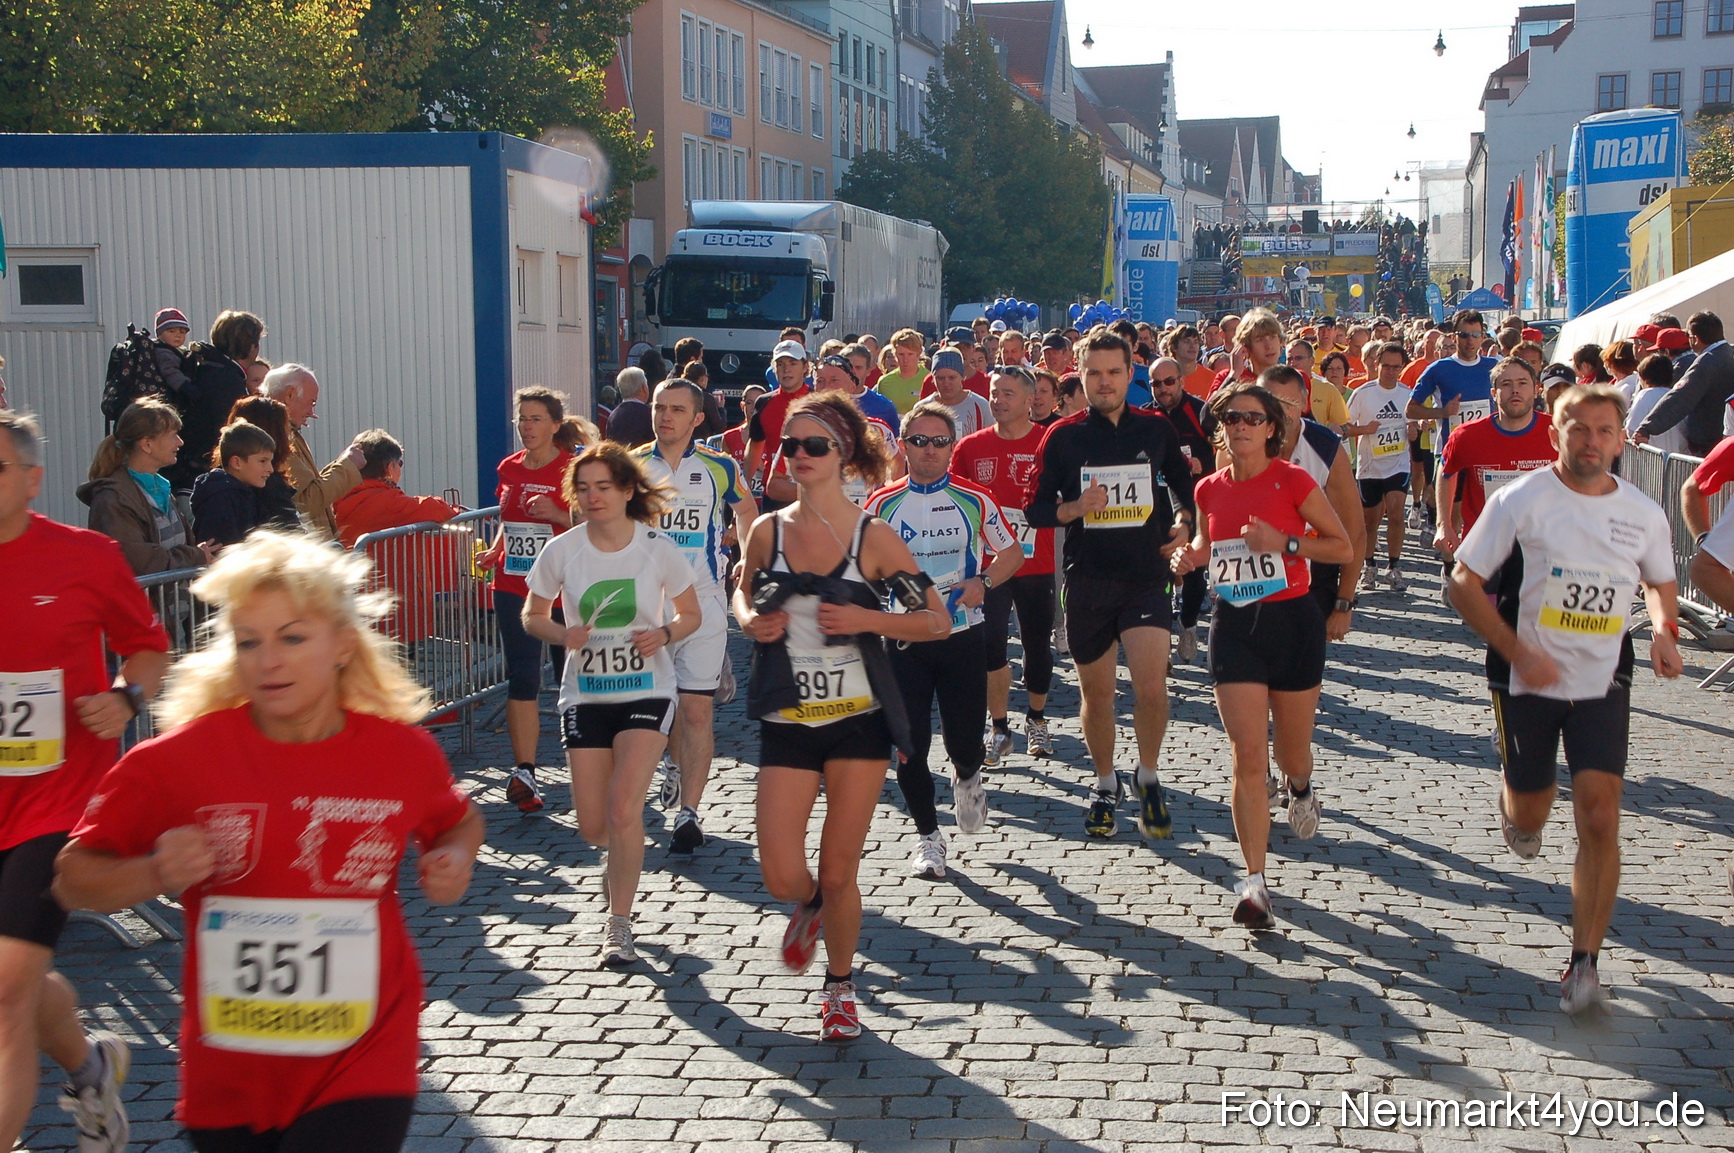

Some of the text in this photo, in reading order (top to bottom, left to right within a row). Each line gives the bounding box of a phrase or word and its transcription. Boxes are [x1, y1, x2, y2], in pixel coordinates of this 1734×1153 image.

[1593, 127, 1670, 170] maxi
[1128, 207, 1163, 231] axi
[703, 233, 773, 248] BOCK
[1141, 243, 1160, 258] dsl
[1376, 411, 1402, 419] adidas
[1378, 431, 1400, 446] 244
[1383, 445, 1399, 453] Luca
[922, 527, 960, 538] PLAST
[508, 536, 548, 556] 2337
[1217, 553, 1276, 583] 2716
[1232, 584, 1264, 598] Anne
[1562, 583, 1616, 613] 323
[1560, 611, 1609, 631] Rudolf
[581, 646, 645, 673] 2158
[586, 676, 642, 691] Ramona
[796, 670, 845, 700] 897
[796, 701, 856, 718] Simone
[235, 940, 331, 996] 551
